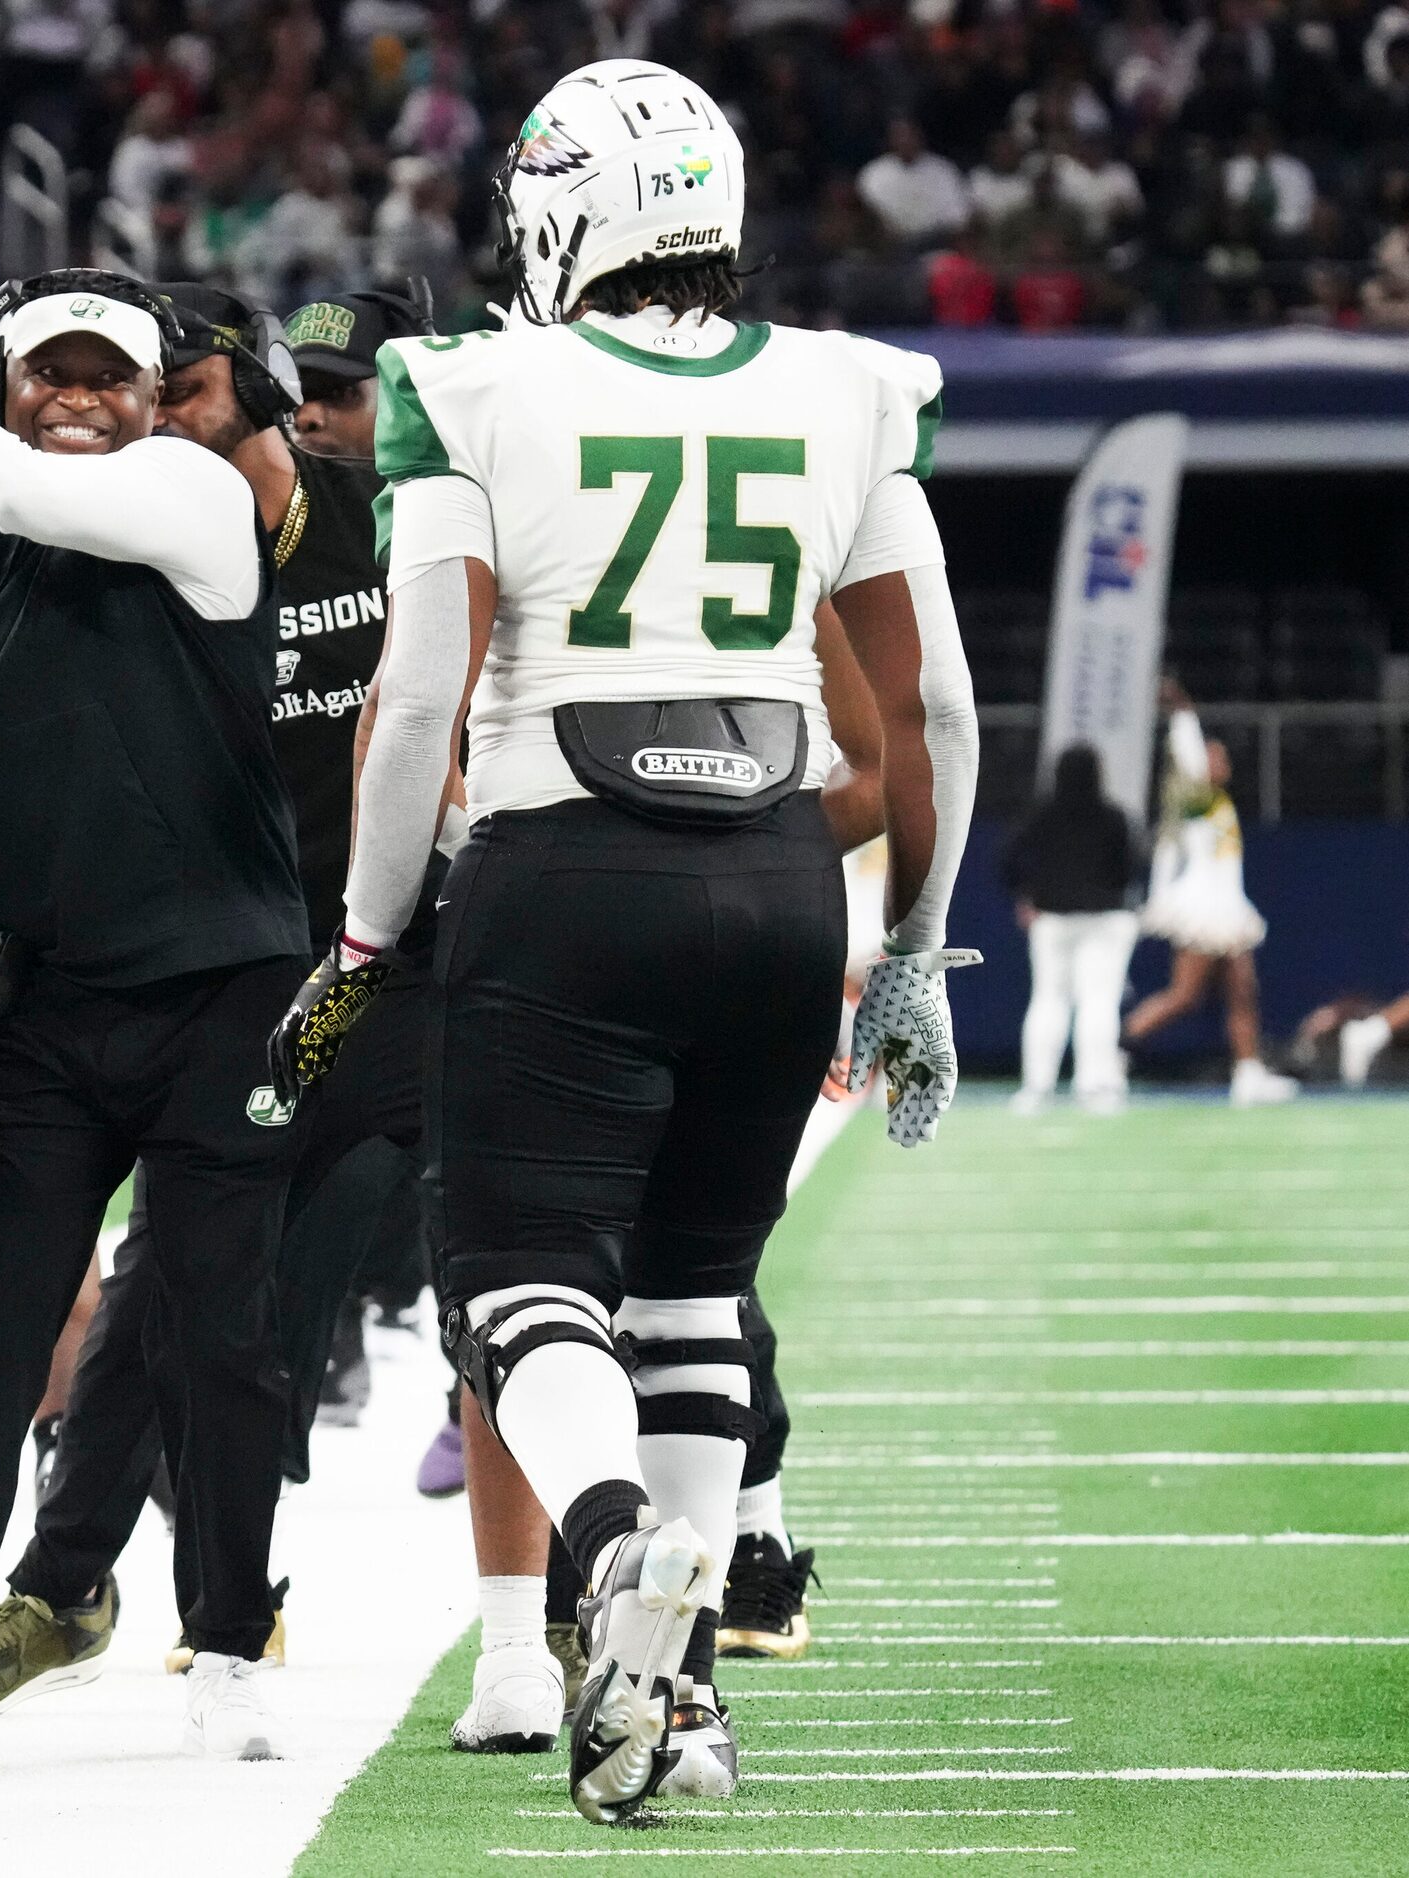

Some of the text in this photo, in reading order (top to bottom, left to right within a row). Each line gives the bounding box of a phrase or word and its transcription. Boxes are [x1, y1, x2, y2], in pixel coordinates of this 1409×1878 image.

[651, 173, 674, 197] 75
[655, 226, 722, 250] schutt
[566, 434, 806, 651] 75
[644, 754, 752, 782] BATTLE
